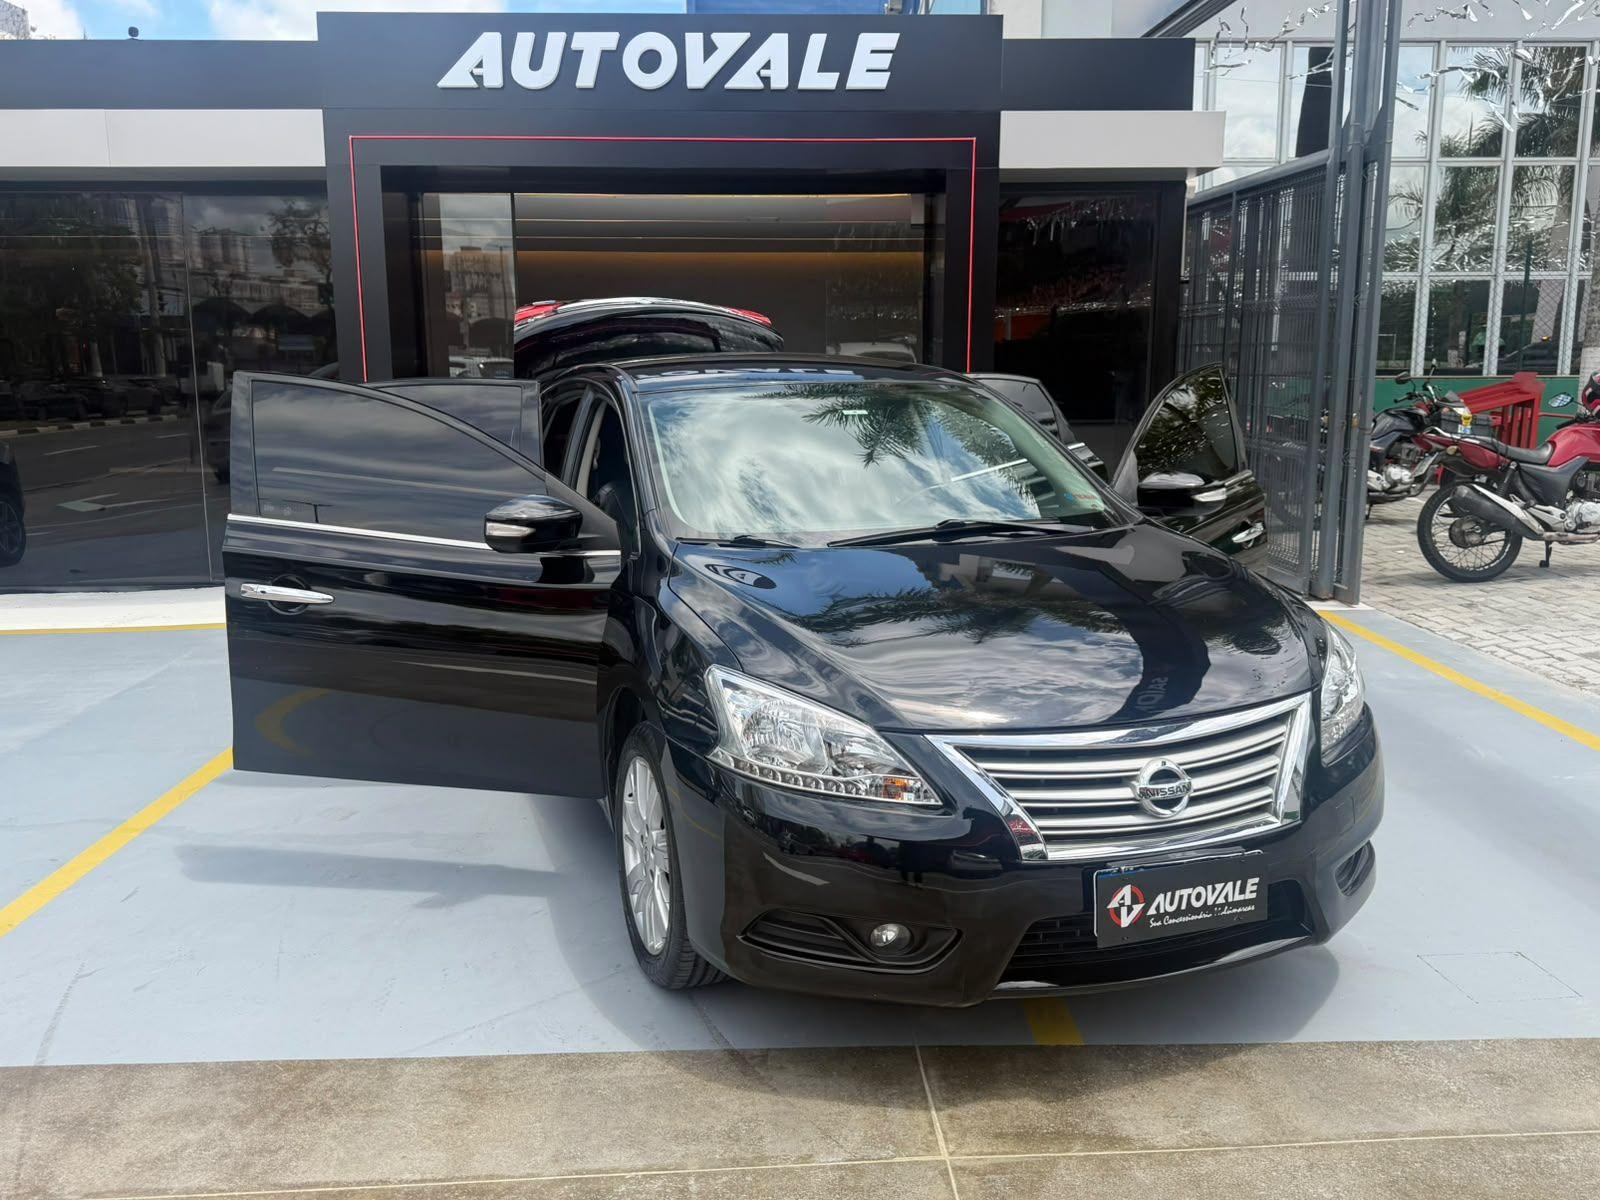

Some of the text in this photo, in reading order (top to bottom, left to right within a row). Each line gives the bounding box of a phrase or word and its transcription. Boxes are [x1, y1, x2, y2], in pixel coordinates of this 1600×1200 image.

[436, 31, 900, 91] AUTOVALE
[1145, 781, 1192, 798] NISSAN
[1146, 877, 1260, 916] AUTOVALE
